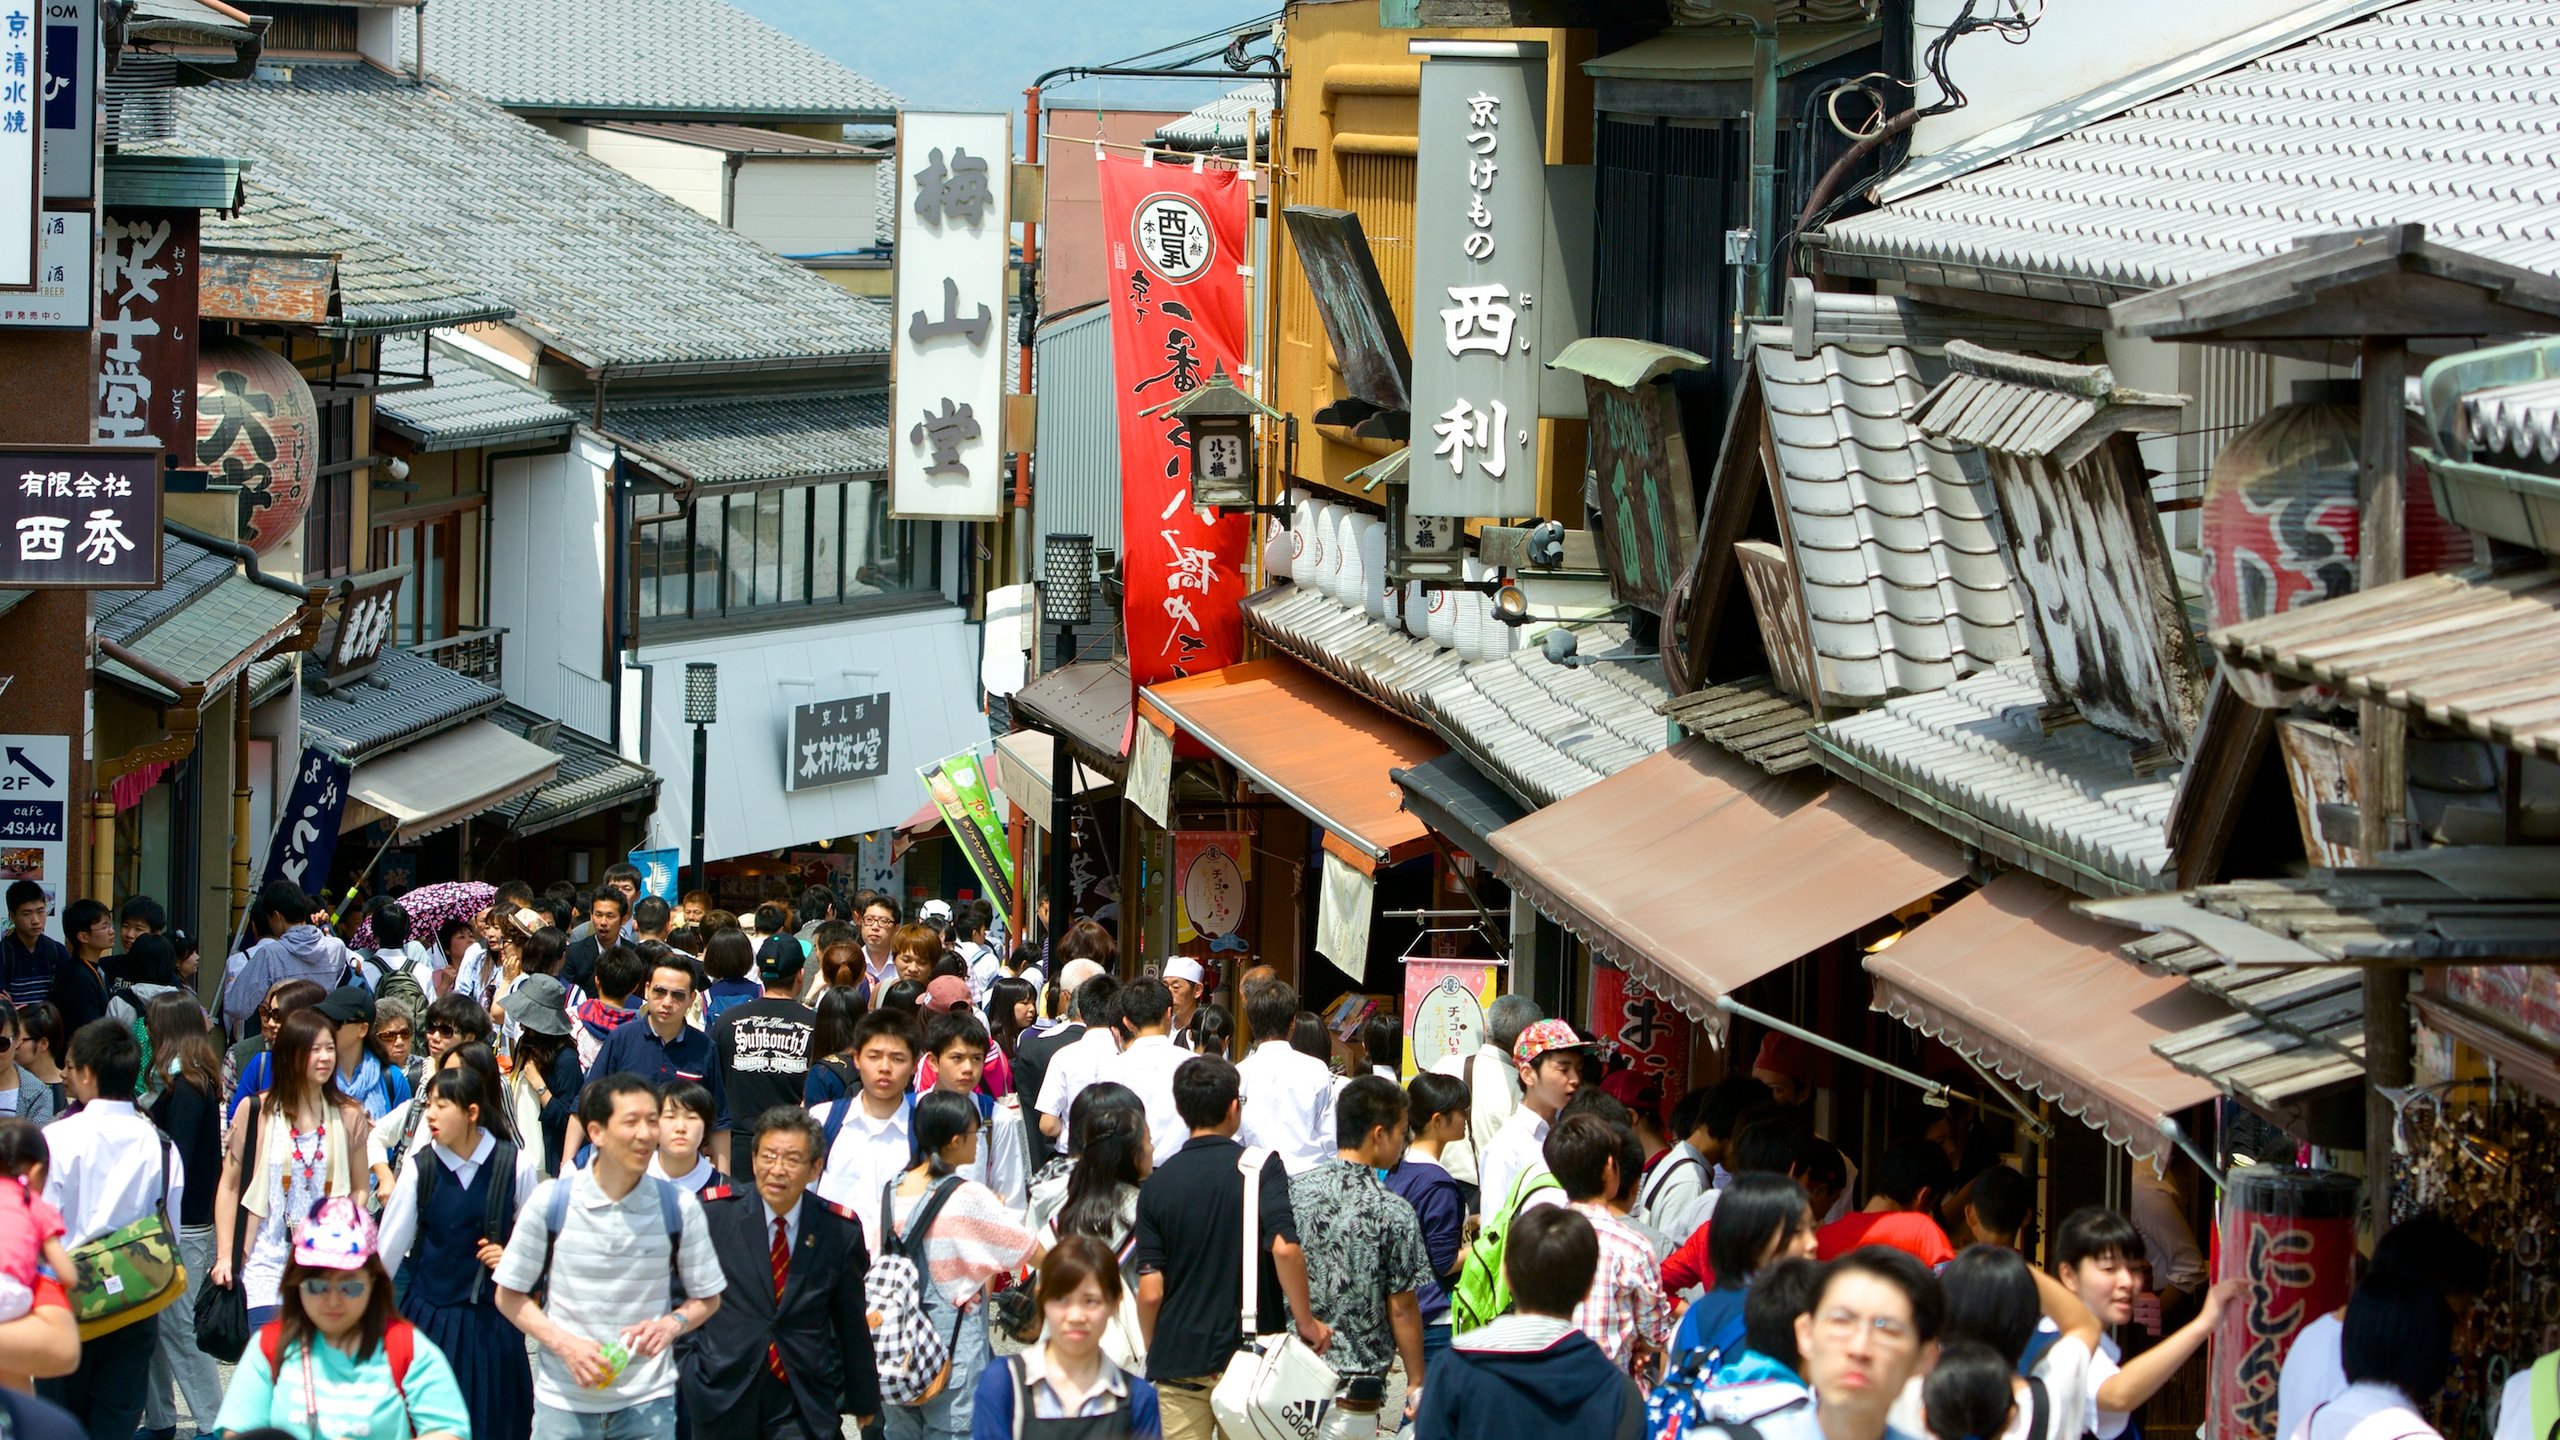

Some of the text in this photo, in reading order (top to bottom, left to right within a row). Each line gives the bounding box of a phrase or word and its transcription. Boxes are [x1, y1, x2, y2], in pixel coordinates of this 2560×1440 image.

[46, 5, 78, 18] OM
[3, 10, 29, 133] 京・清水焼
[1463, 91, 1500, 260] 京つけもの
[908, 146, 994, 477] 梅山堂
[1434, 283, 1517, 478] 西利
[18, 470, 134, 499] 有限会社
[1414, 516, 1436, 549] ツ橋
[821, 703, 865, 727] 京人形
[2, 776, 31, 790] 2F
